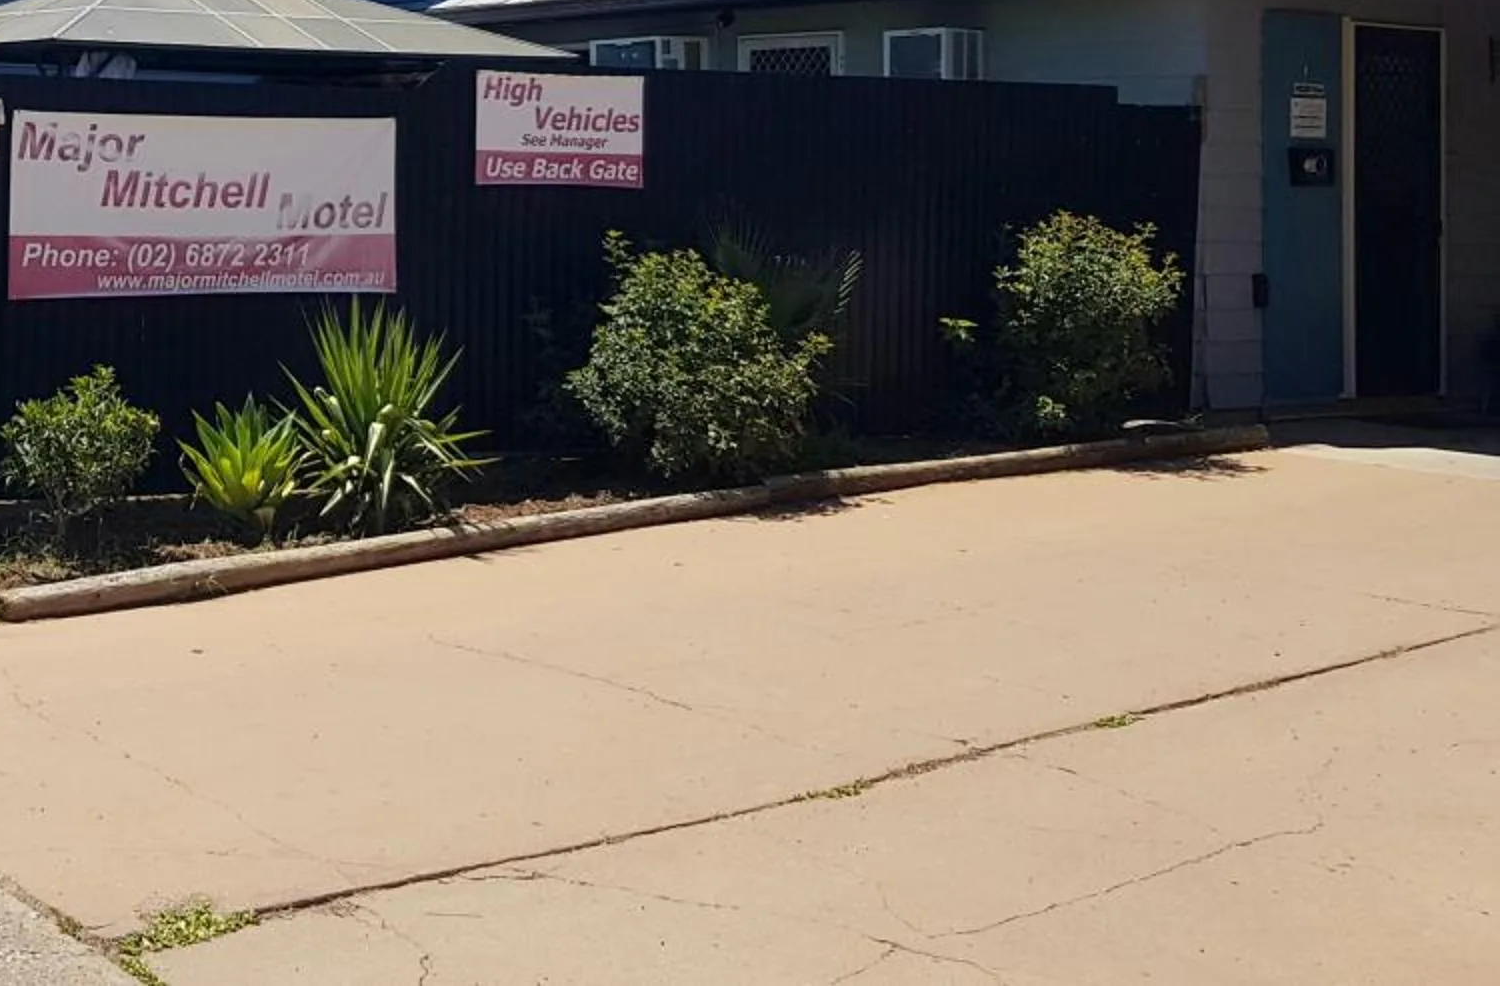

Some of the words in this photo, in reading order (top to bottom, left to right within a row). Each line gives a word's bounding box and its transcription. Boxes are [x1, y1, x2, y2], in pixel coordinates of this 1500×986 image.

[483, 76, 543, 107] High
[535, 105, 640, 133] Vehicles
[17, 121, 146, 172] Major
[521, 132, 547, 147] See
[550, 134, 609, 150] Manager
[486, 156, 526, 178] Use
[531, 157, 583, 180] Back
[589, 159, 639, 181] Gate
[101, 168, 271, 209] Mitchell
[22, 242, 119, 268] Phone:
[127, 243, 176, 273] (02)
[185, 243, 246, 268] 6872
[253, 242, 310, 267] 2311
[97, 269, 386, 291] www.majormitchellmotel.com.au
